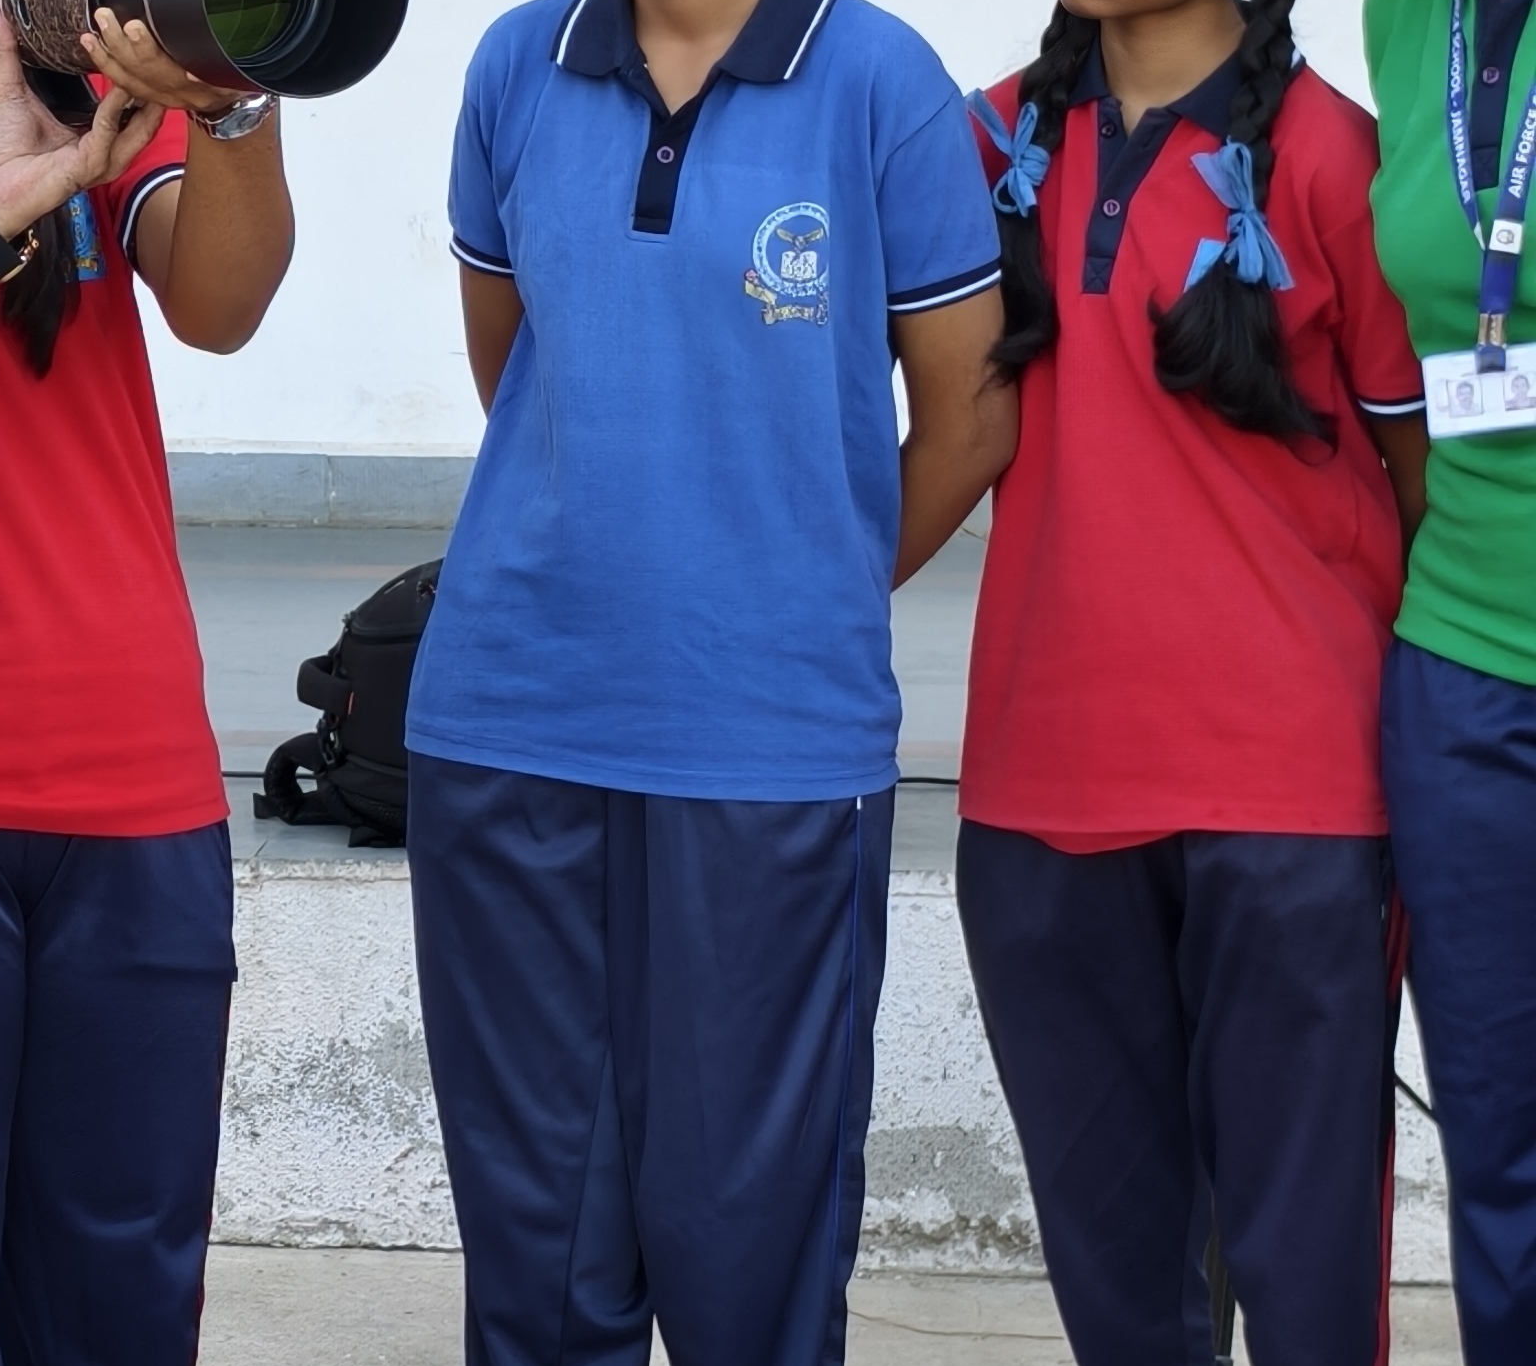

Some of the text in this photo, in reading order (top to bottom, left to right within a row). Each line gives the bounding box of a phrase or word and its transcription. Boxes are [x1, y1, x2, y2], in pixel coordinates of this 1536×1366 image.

[1450, 110, 1472, 205] JAMNAGAR
[1508, 108, 1536, 199] AIR FORCE
